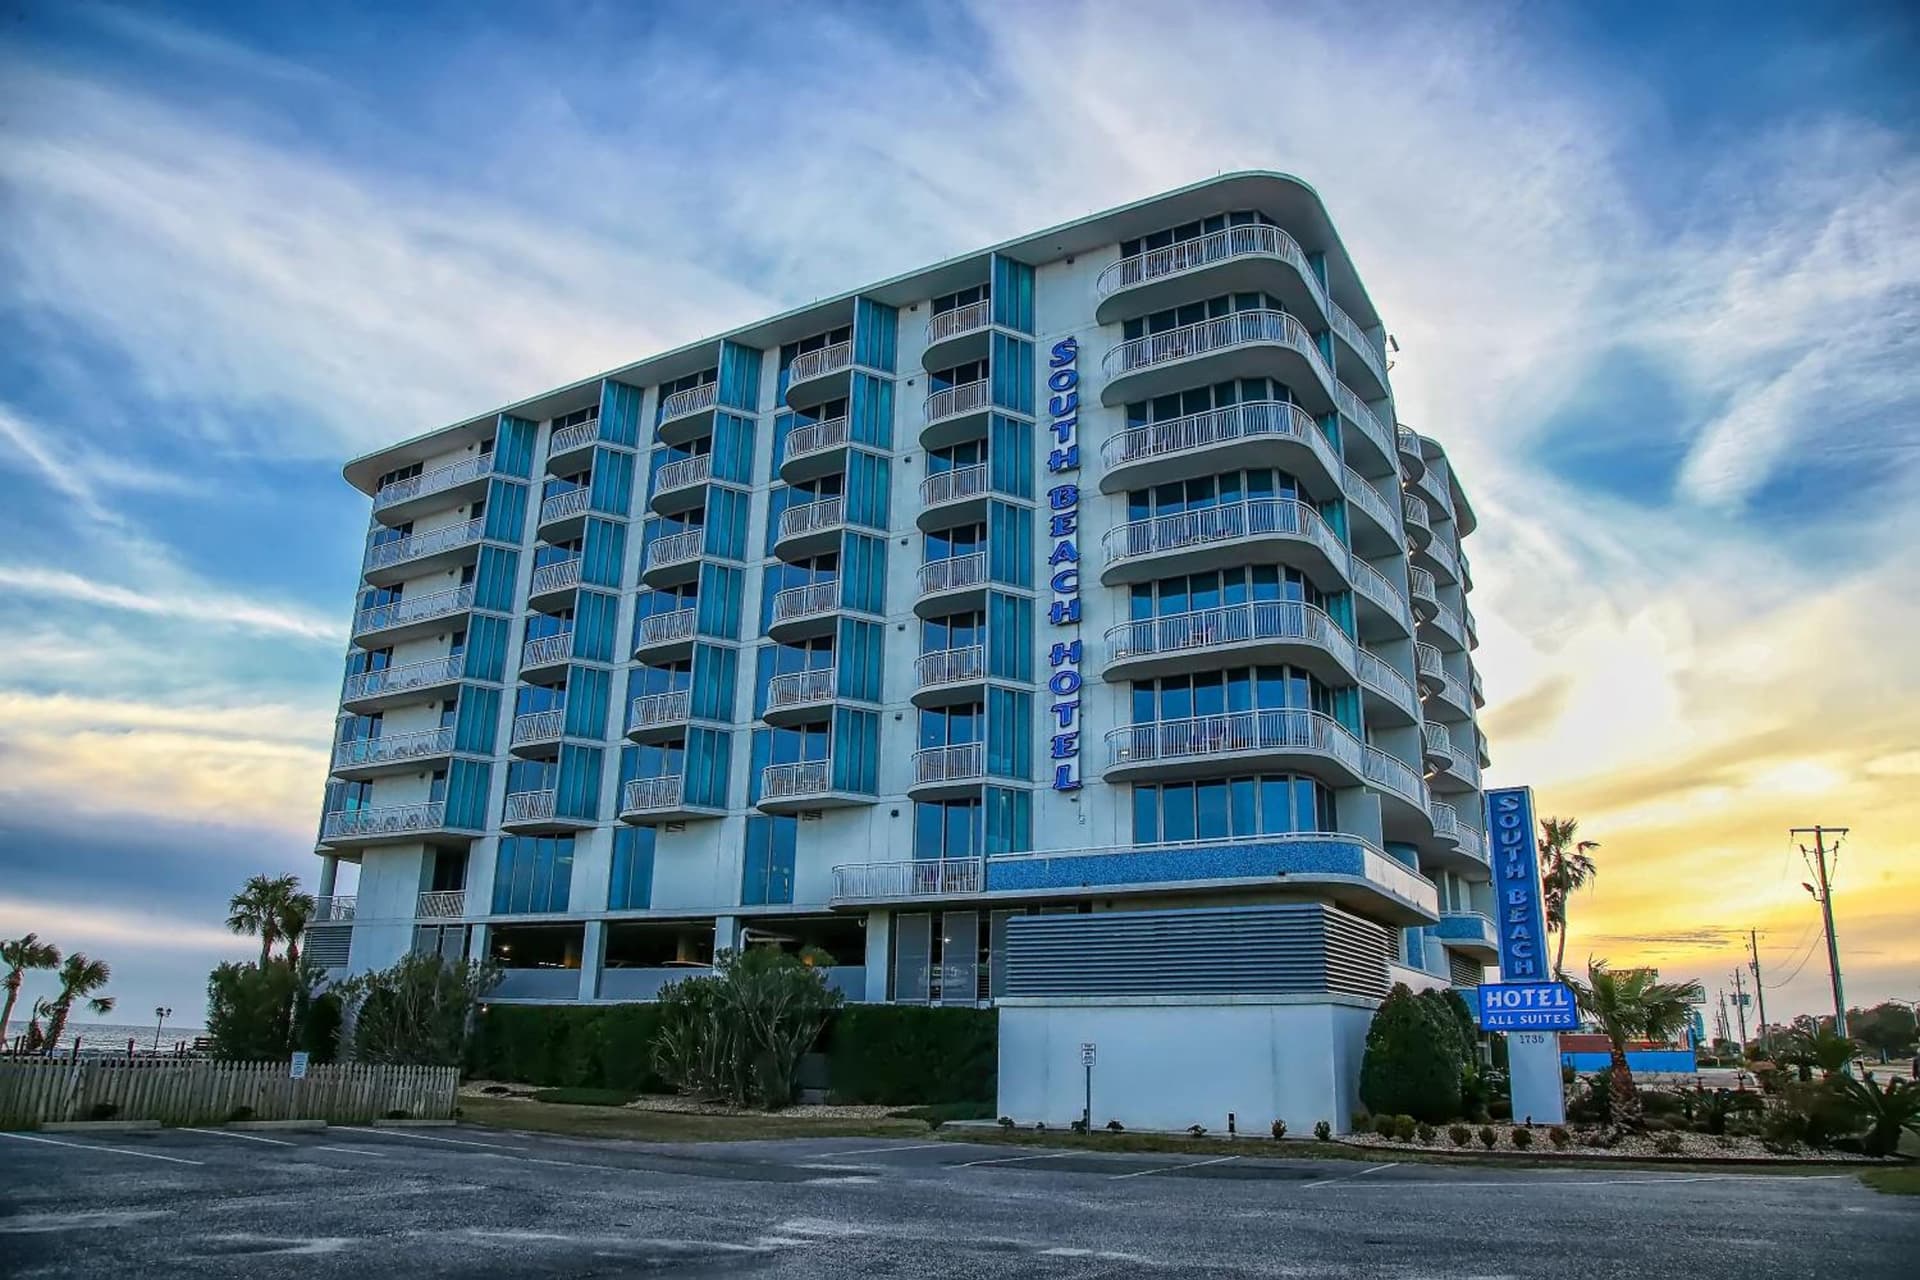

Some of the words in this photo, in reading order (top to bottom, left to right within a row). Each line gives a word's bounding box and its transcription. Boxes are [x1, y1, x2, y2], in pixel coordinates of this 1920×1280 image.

[1048, 337, 1080, 473] SOUTH
[1047, 484, 1082, 625] BEACH
[1048, 639, 1083, 792] HOTEL
[1498, 795, 1526, 879] SOUTH
[1506, 888, 1534, 975] BEACH
[1486, 988, 1569, 1009] HOTEL
[1487, 1015, 1514, 1025] ALL
[1519, 1013, 1571, 1025] SUITES
